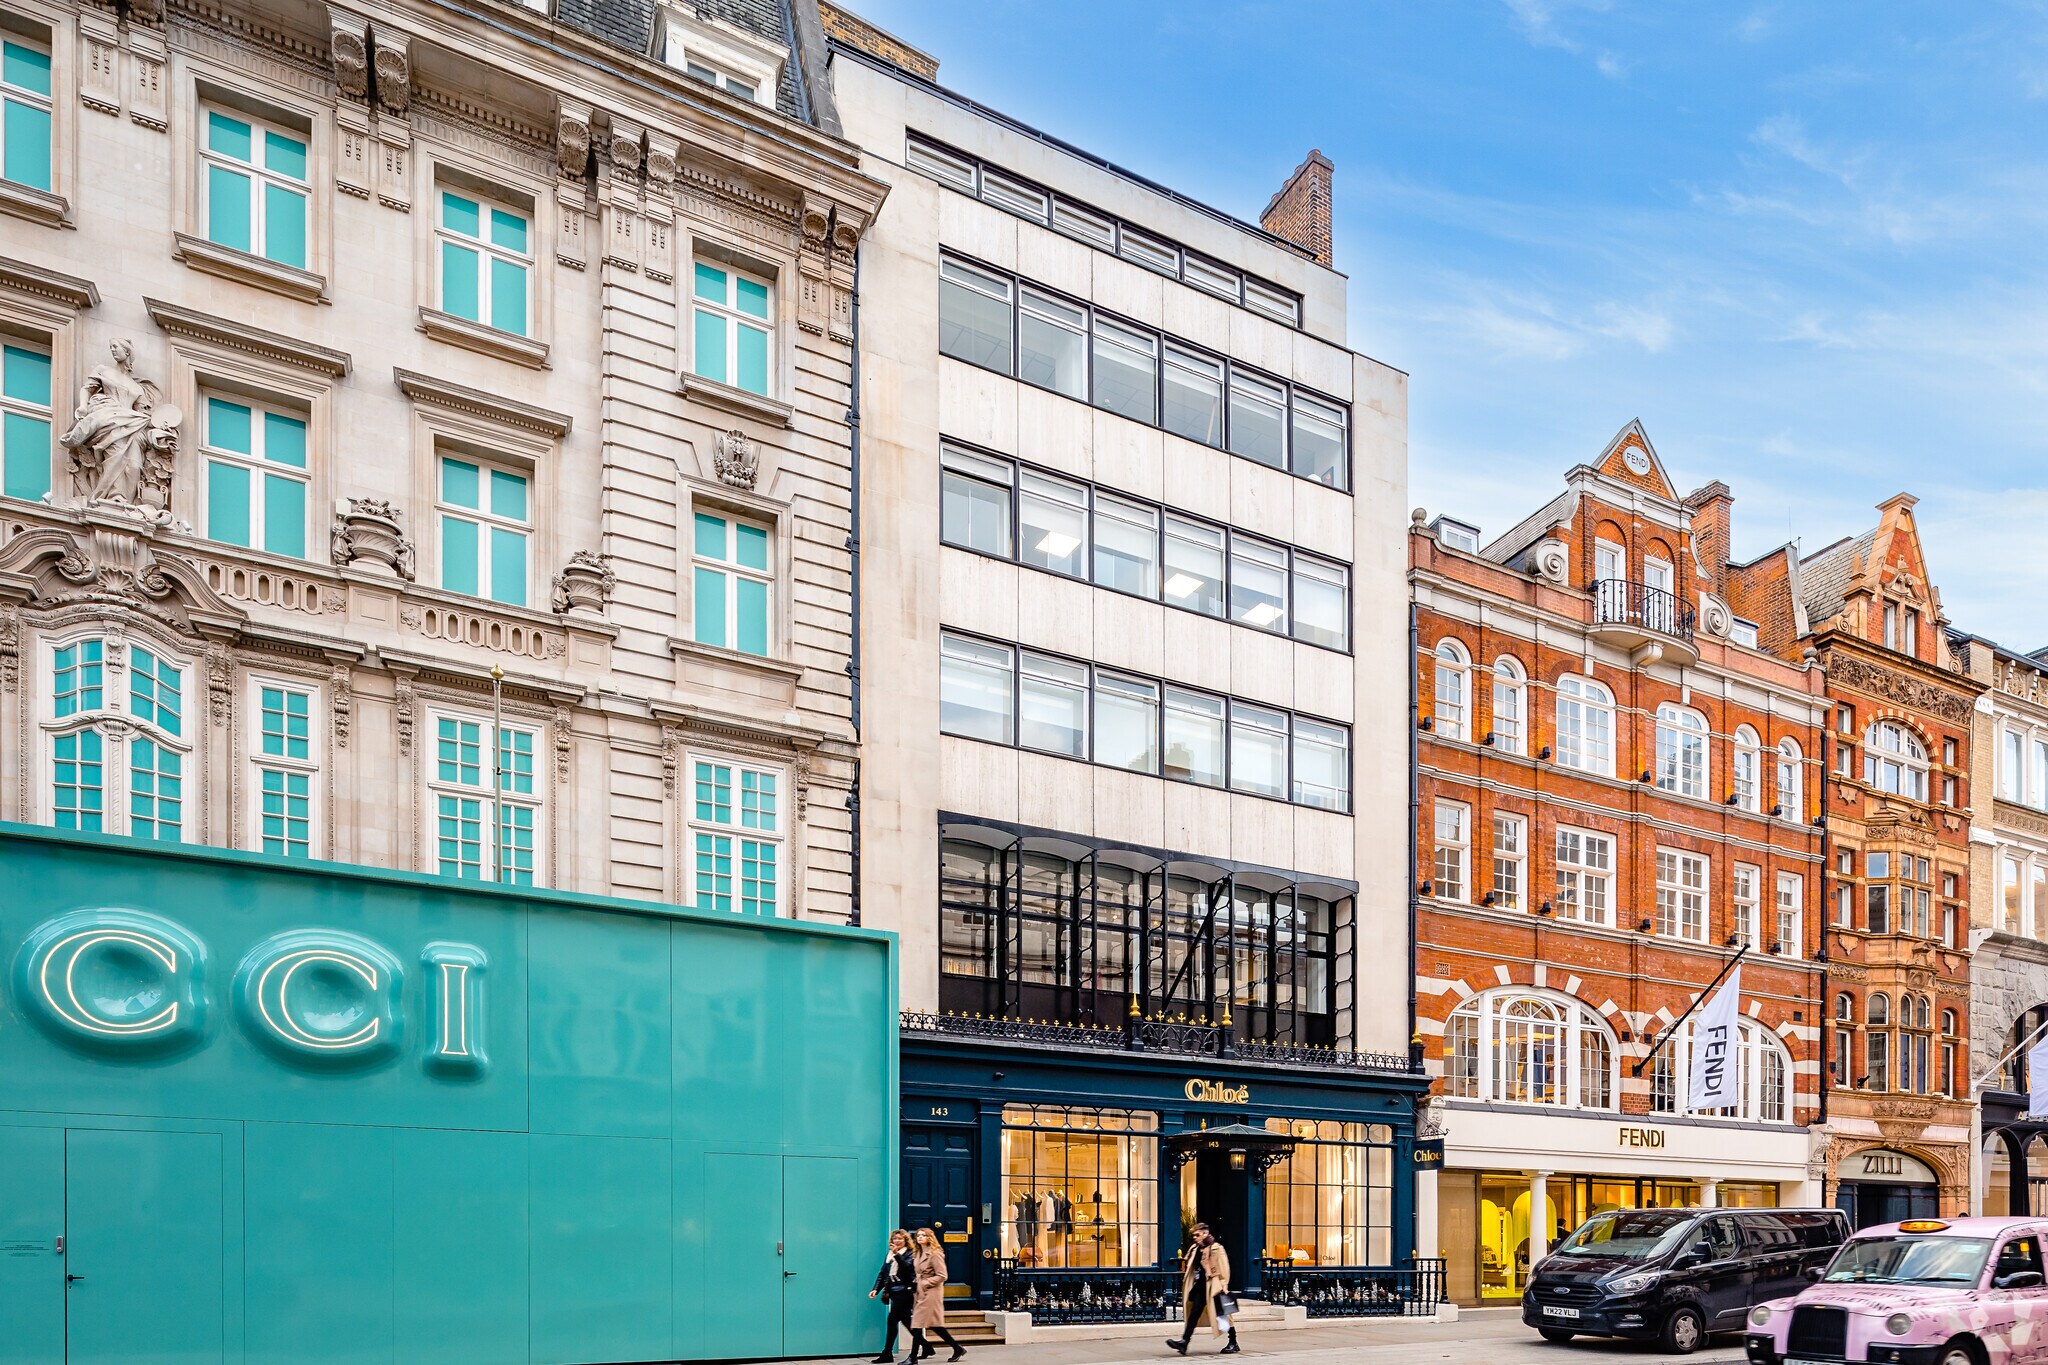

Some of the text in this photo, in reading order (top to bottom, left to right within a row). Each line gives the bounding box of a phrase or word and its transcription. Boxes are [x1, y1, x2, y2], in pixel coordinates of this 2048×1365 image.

[1626, 452, 1649, 469] FENDI
[1704, 1025, 1727, 1097] FENDI
[931, 1107, 948, 1116] 143
[1619, 1127, 1665, 1148] FENDI
[1862, 1154, 1903, 1175] ZILLI
